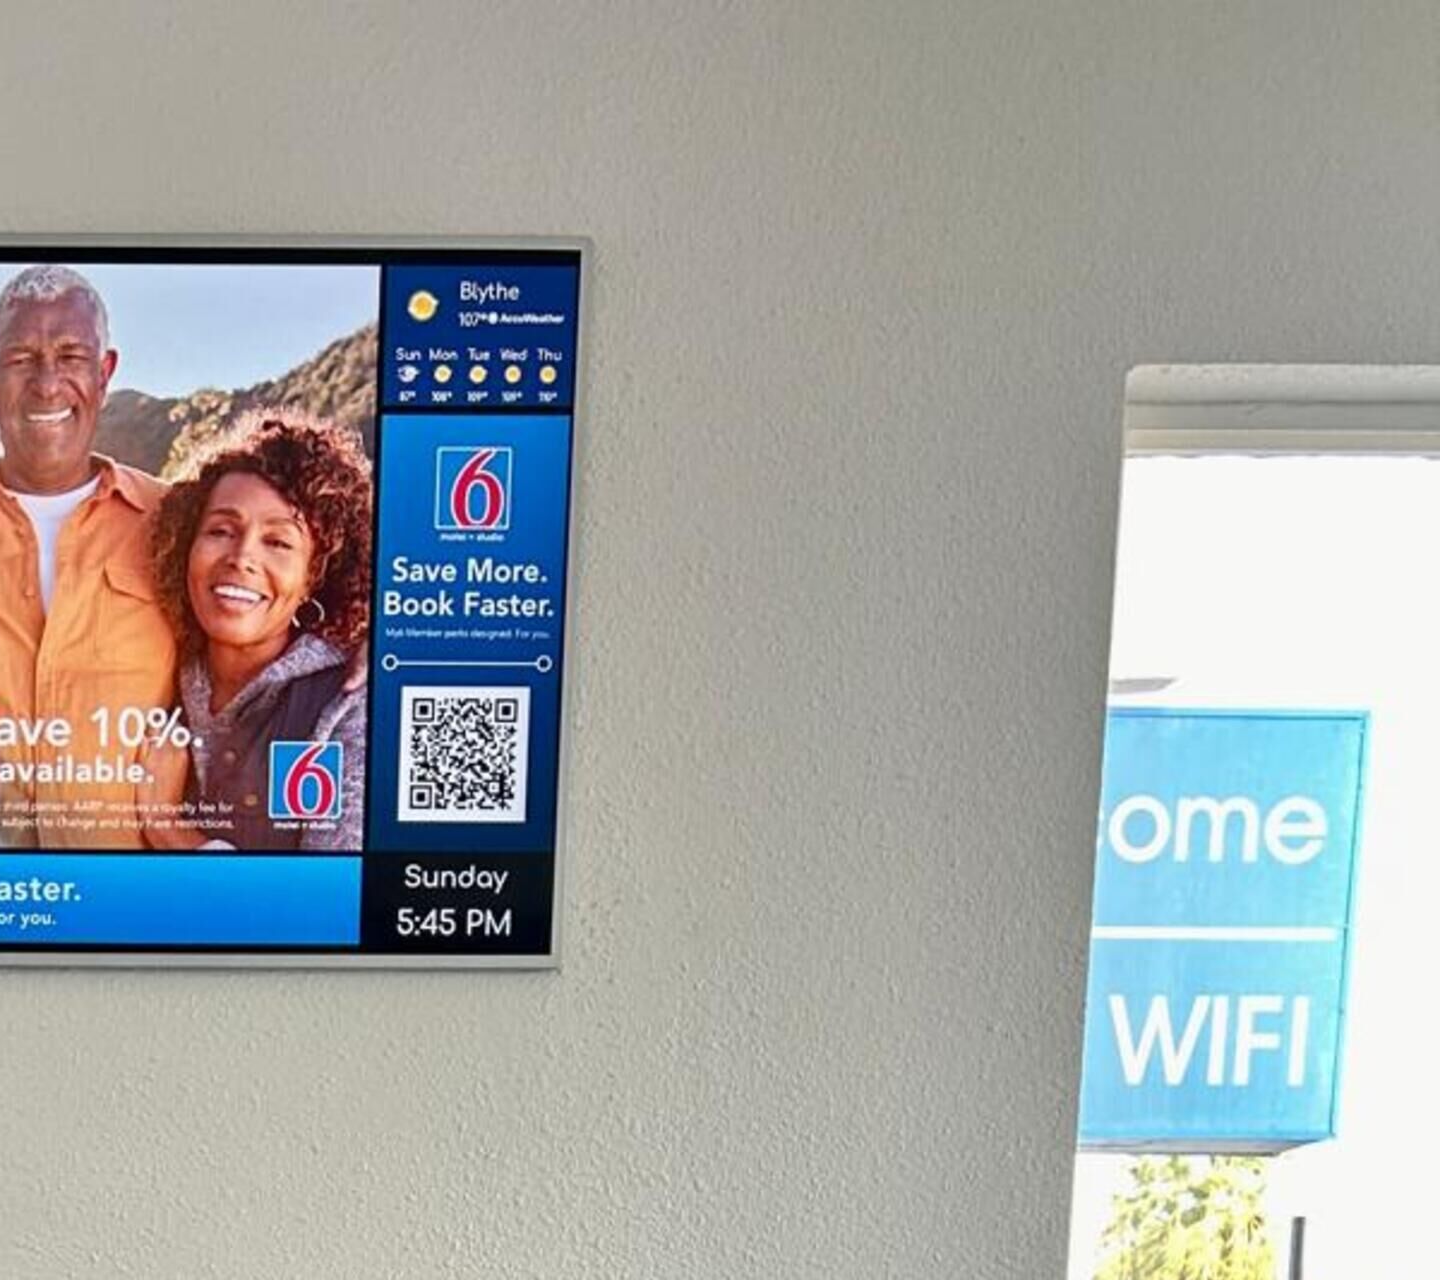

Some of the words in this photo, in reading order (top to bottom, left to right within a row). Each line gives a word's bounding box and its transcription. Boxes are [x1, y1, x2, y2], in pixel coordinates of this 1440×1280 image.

[459, 281, 520, 304] Blythe
[498, 312, 564, 324] AccuWeather
[396, 348, 421, 361] Sun
[429, 348, 458, 361] Mon
[467, 348, 490, 361] Tue
[500, 348, 528, 361] Wed
[537, 348, 562, 361] Thu
[451, 446, 504, 530] 6
[392, 557, 456, 582] Save
[468, 558, 548, 583] More.
[384, 591, 454, 616] Book
[464, 592, 554, 617] Faster.
[90, 707, 204, 748] 10%.
[285, 743, 336, 818] 6
[160, 802, 196, 814] royalty
[199, 802, 216, 812] fee
[219, 802, 234, 812] for
[2, 816, 38, 830] subject
[43, 817, 54, 827] to
[99, 818, 120, 828] and
[123, 819, 144, 831] may
[147, 818, 172, 828] have
[1098, 795, 1327, 865] ome
[404, 864, 509, 894] Sunday
[21, 912, 57, 927] you.
[397, 909, 456, 935] 5:45
[467, 909, 512, 935] PM
[1109, 994, 1311, 1087] WIFI
